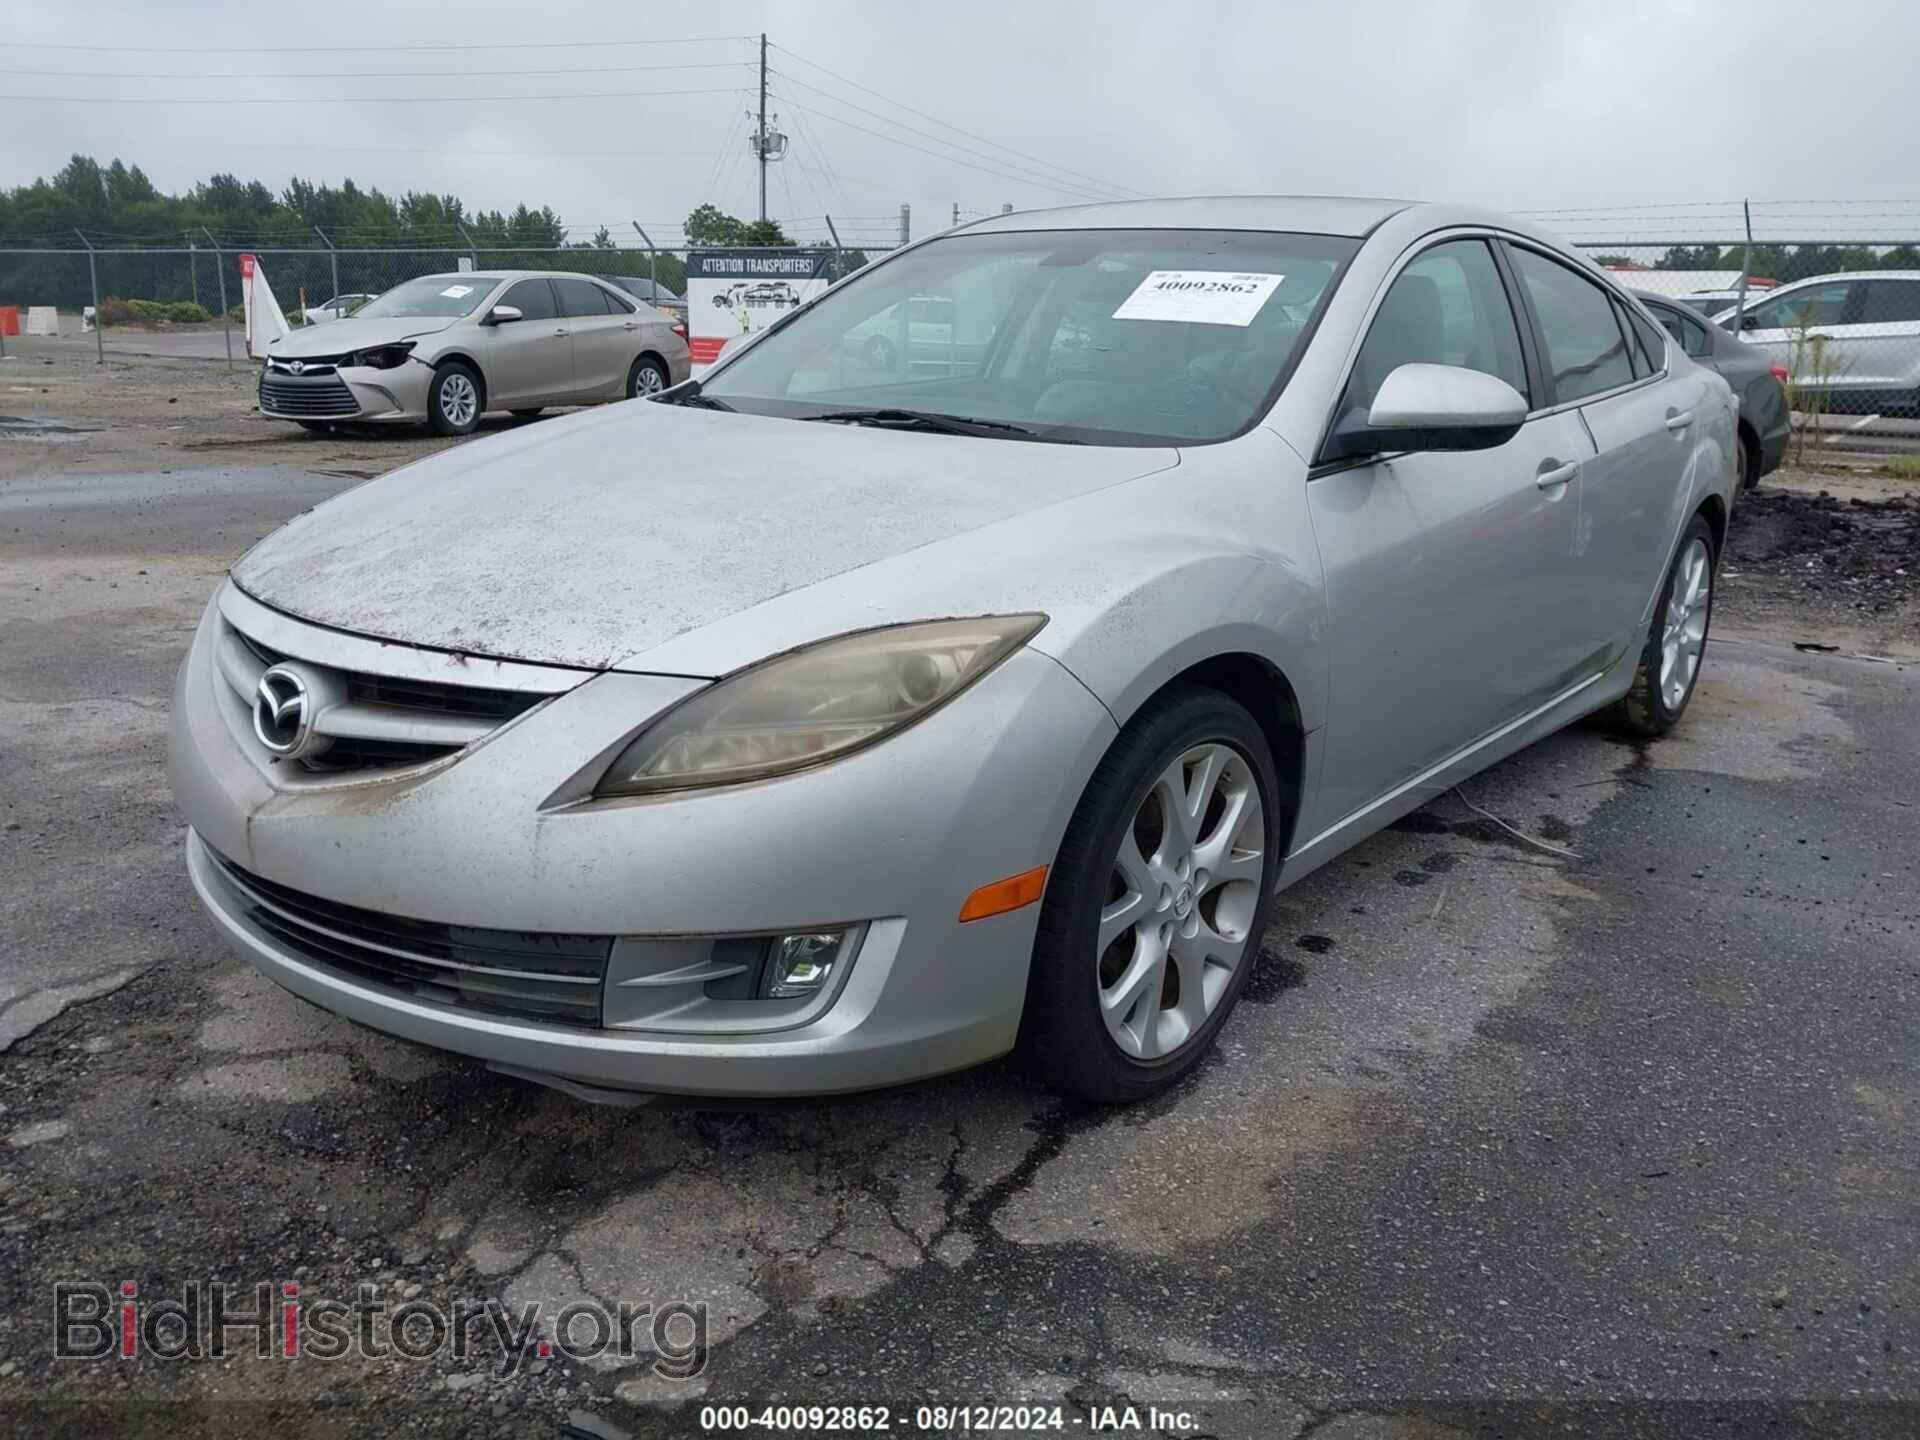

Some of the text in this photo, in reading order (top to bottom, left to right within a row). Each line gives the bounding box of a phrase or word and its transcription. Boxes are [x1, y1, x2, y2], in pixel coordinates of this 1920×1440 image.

[702, 258, 814, 272] ATTENTION TRANSPORTERS!
[1153, 281, 1258, 293] 40092862
